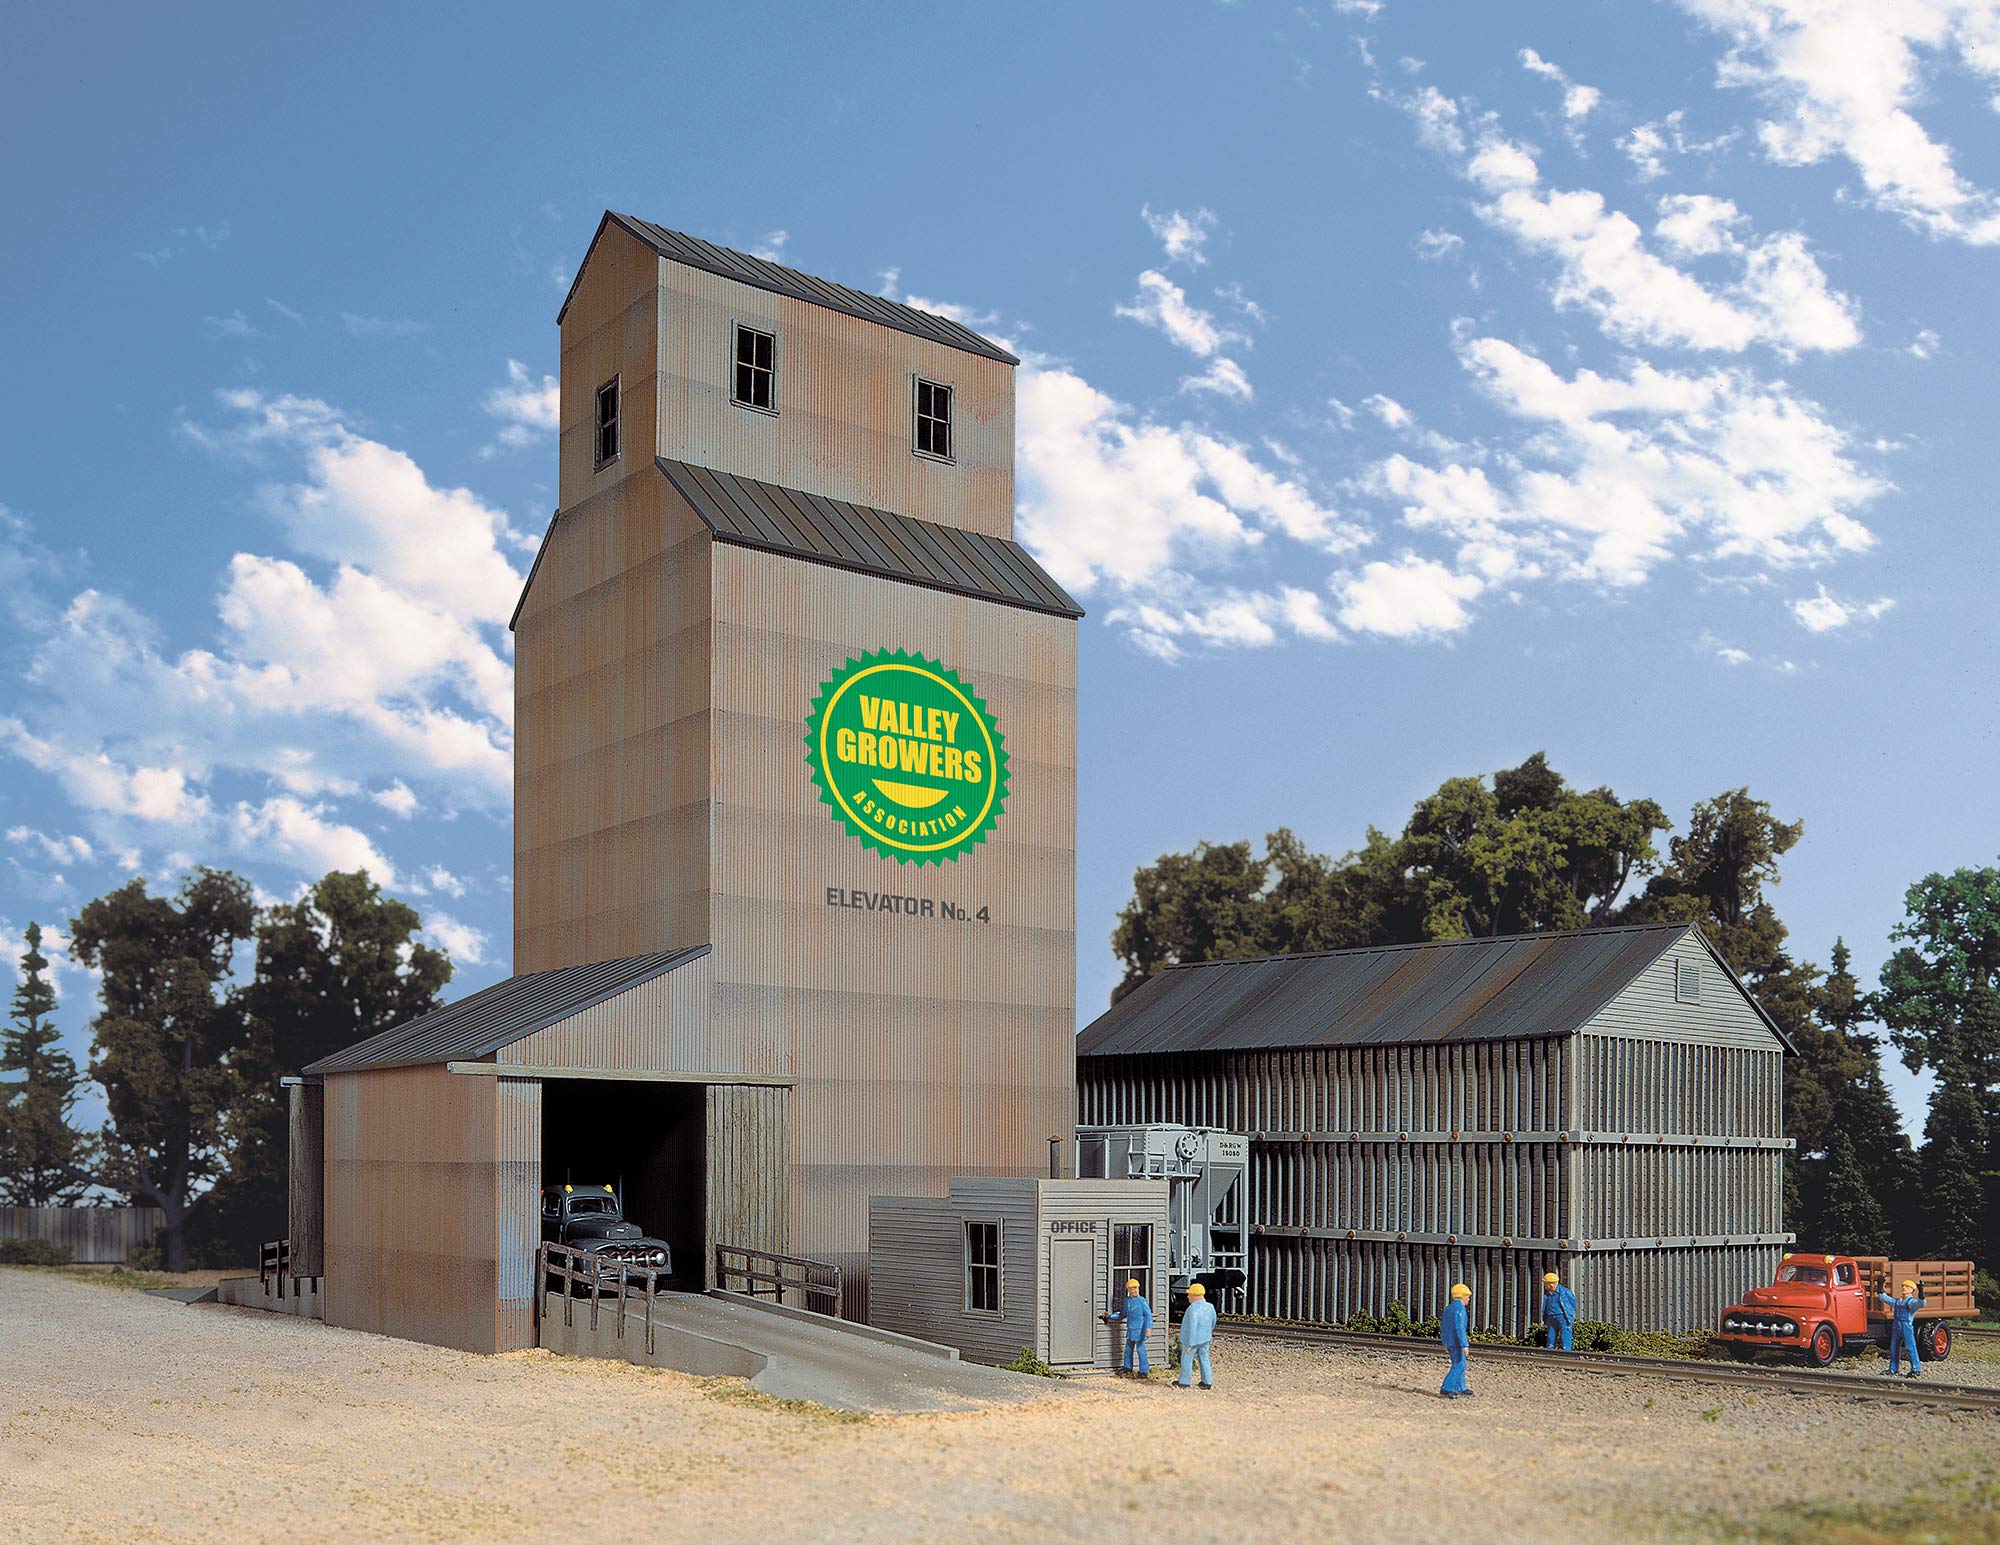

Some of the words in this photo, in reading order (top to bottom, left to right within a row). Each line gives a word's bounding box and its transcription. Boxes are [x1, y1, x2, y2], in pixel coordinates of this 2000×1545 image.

[859, 694, 960, 744] VALLEY
[836, 727, 982, 783] GROWERS
[852, 790, 967, 836] ASSOCIATION
[826, 887, 934, 917] ELEVATOR
[942, 901, 971, 922] No.
[976, 906, 990, 923] 4
[1051, 1221, 1097, 1233] OFFICE
